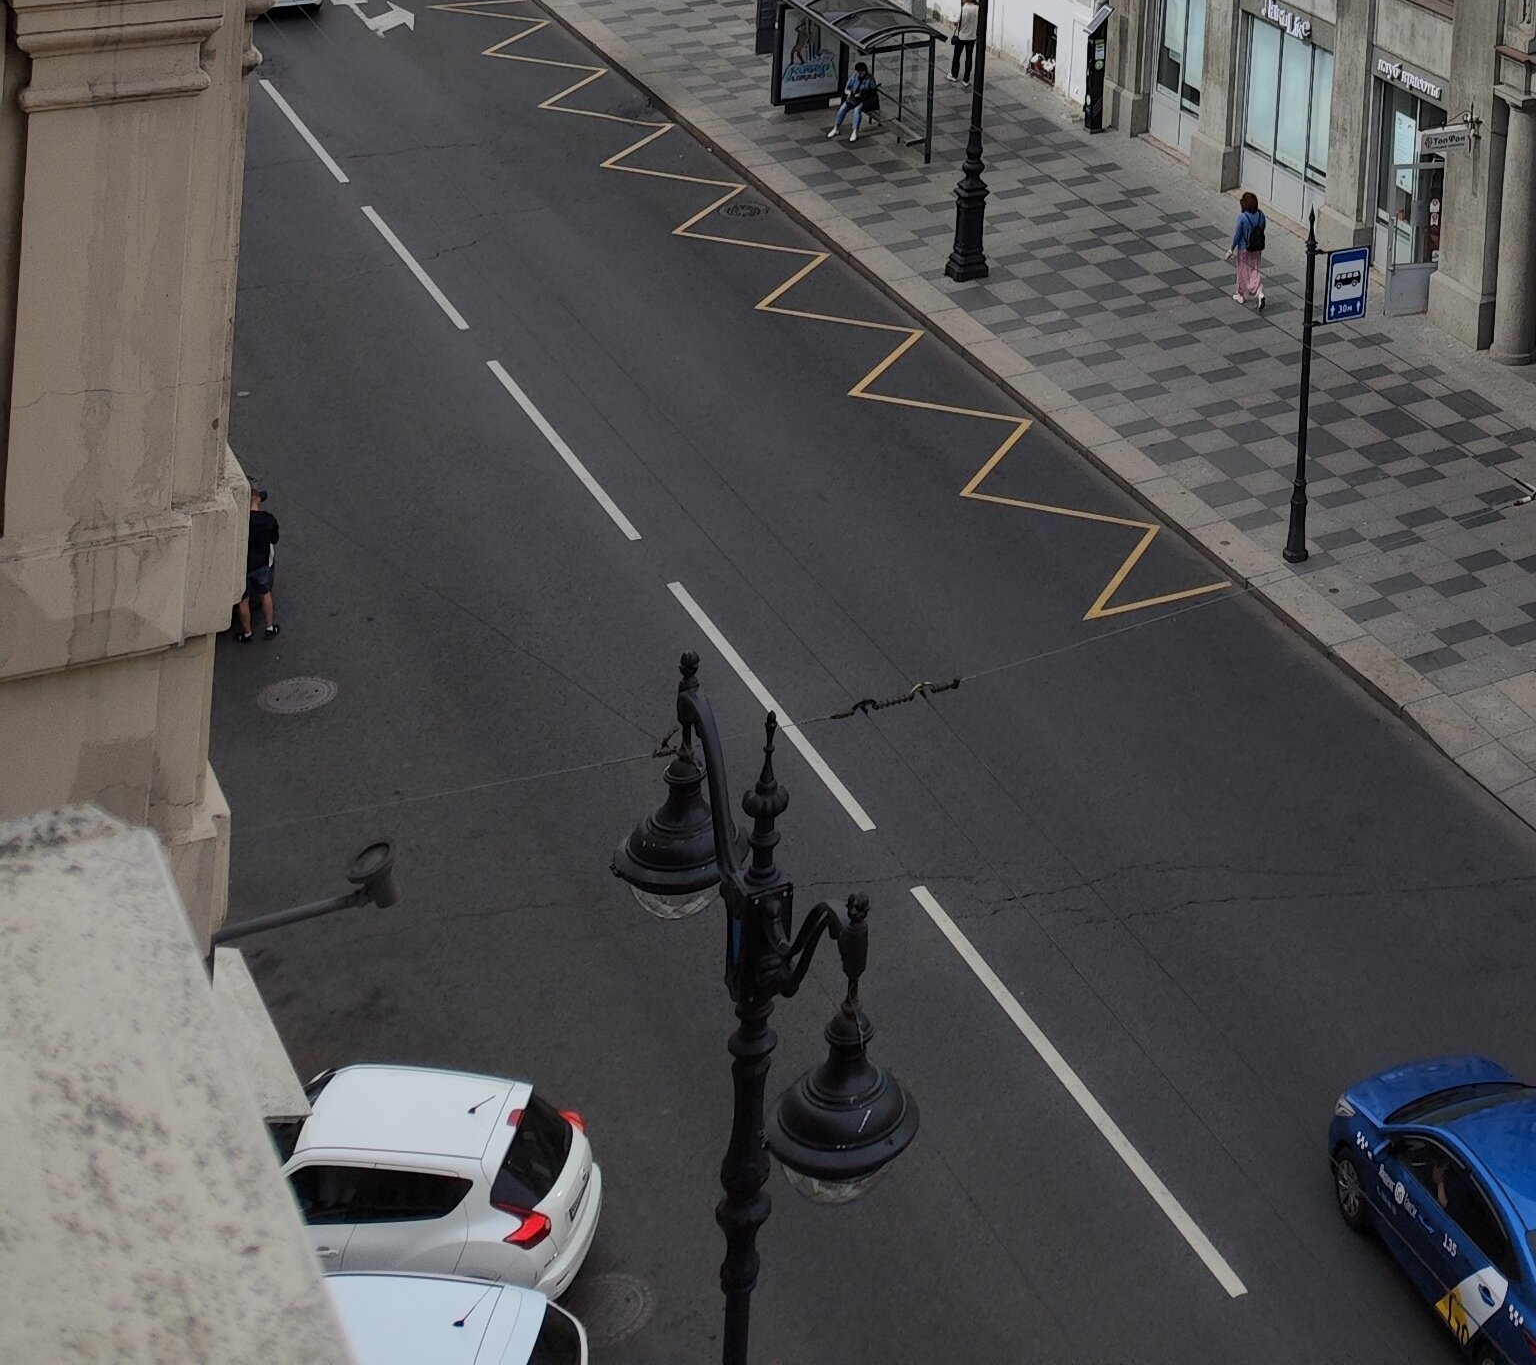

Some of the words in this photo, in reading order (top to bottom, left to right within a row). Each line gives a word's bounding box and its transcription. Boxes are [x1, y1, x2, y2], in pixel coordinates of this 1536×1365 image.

[1378, 59, 1401, 79] клуб
[1401, 71, 1441, 99] красоты
[1434, 135, 1465, 145] ТопФон
